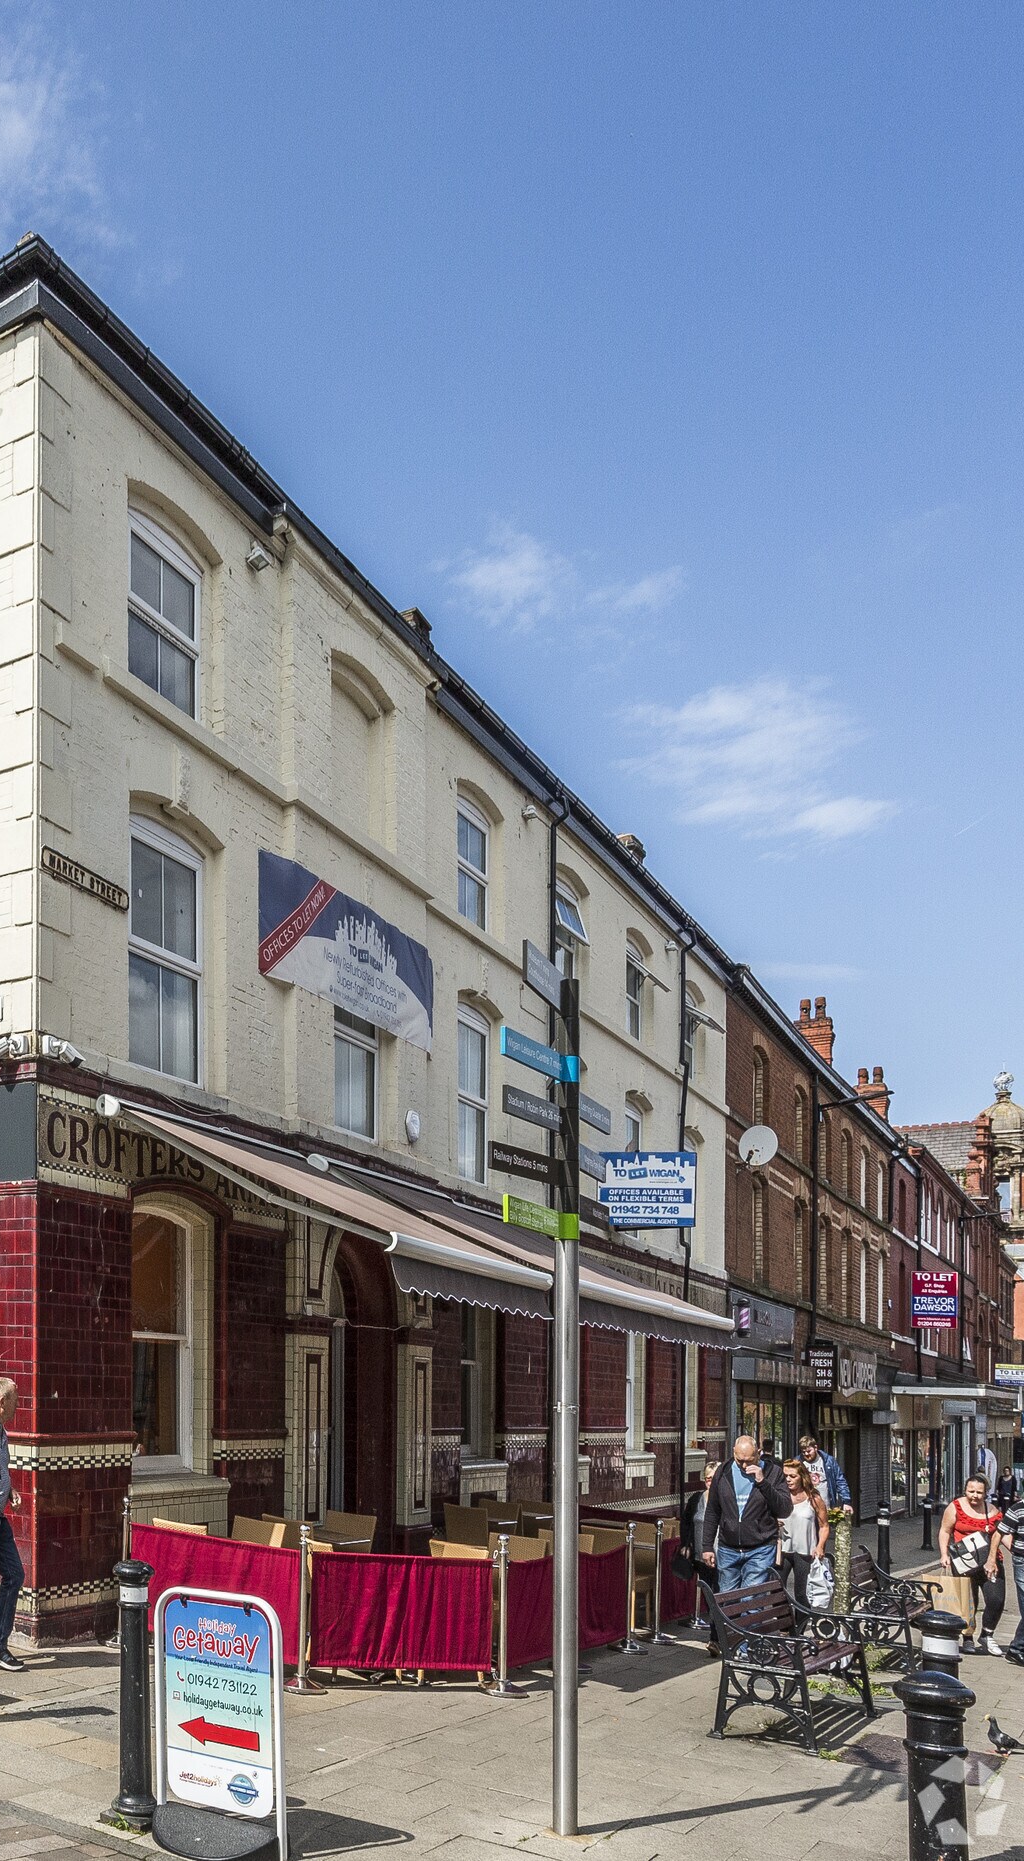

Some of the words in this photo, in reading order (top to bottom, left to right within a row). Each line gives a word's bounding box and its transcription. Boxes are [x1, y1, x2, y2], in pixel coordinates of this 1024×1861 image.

[48, 853, 85, 884] MARKET
[90, 877, 122, 905] STREET
[262, 927, 295, 962] OFFICES
[291, 916, 303, 933] TO
[302, 908, 314, 925] LET
[349, 943, 357, 957] TO
[359, 952, 369, 960] LET
[376, 977, 397, 998] Offices
[508, 1093, 525, 1109] Stadium
[527, 1101, 539, 1114] Robin
[539, 1106, 548, 1118] Park
[47, 1111, 205, 1182] CROFTERS
[494, 1149, 513, 1166] Railway
[513, 1154, 532, 1169] Stations
[532, 1160, 536, 1170] 5
[537, 1162, 548, 1173] mins
[613, 1169, 627, 1177] TO
[648, 1169, 680, 1178] WIGAN
[611, 1205, 641, 1214] 01942
[642, 1206, 660, 1214] 734
[662, 1206, 680, 1215] 748
[915, 1273, 931, 1281] TO
[933, 1273, 954, 1282] LET
[914, 1297, 955, 1305] TREVOR
[914, 1304, 955, 1312] DAWSON
[810, 1359, 833, 1367] FRESH
[816, 1379, 832, 1388] HIPS
[198, 1618, 236, 1637] Holiday
[173, 1625, 260, 1665] Getaway
[187, 1673, 220, 1689] 01942
[222, 1679, 257, 1696] 731122
[183, 1691, 263, 1717] holidaygetaway.co.uk
[179, 1771, 218, 1787] Jet2holidays
